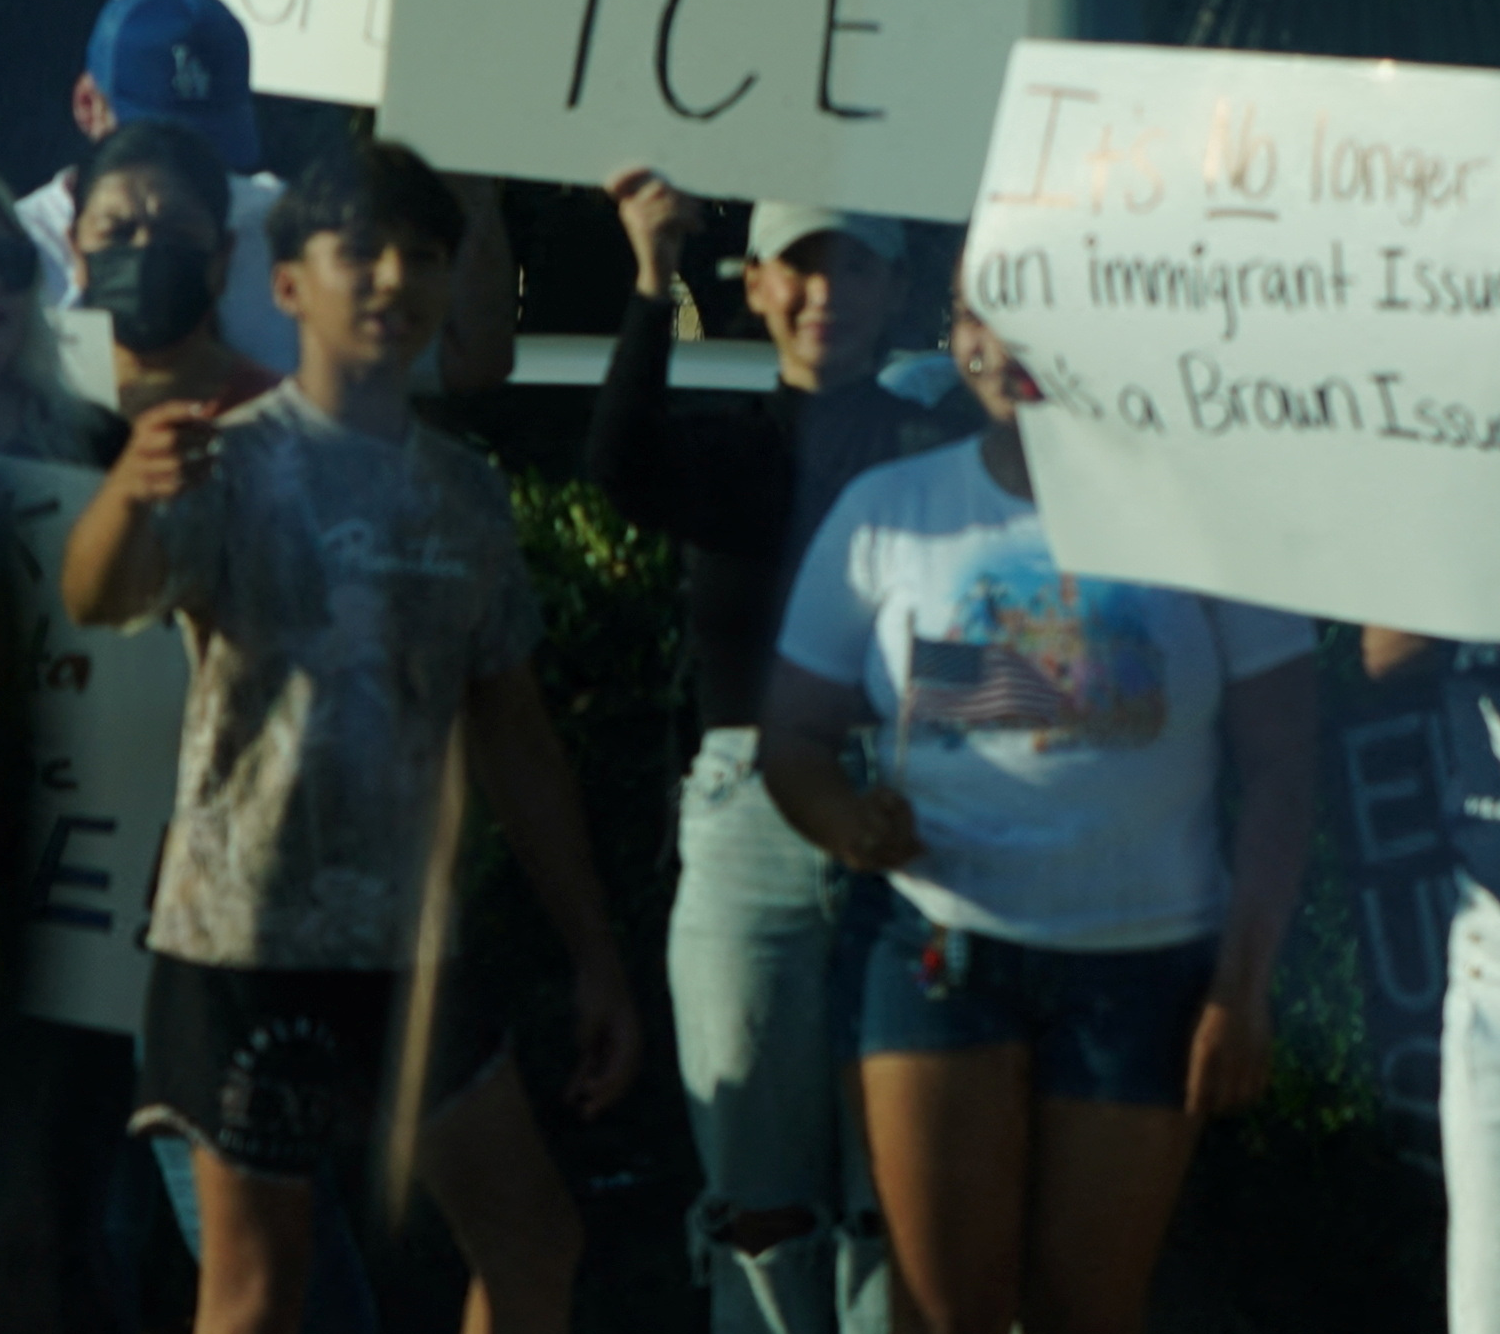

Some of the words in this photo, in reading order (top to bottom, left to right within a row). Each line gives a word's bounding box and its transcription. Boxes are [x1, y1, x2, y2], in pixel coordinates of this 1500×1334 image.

[988, 82, 1168, 216] It's
[1202, 95, 1280, 201] No
[1310, 112, 1490, 226] longer
[977, 246, 1054, 311] an
[1087, 234, 1355, 342] immigrant
[1118, 383, 1165, 435] a
